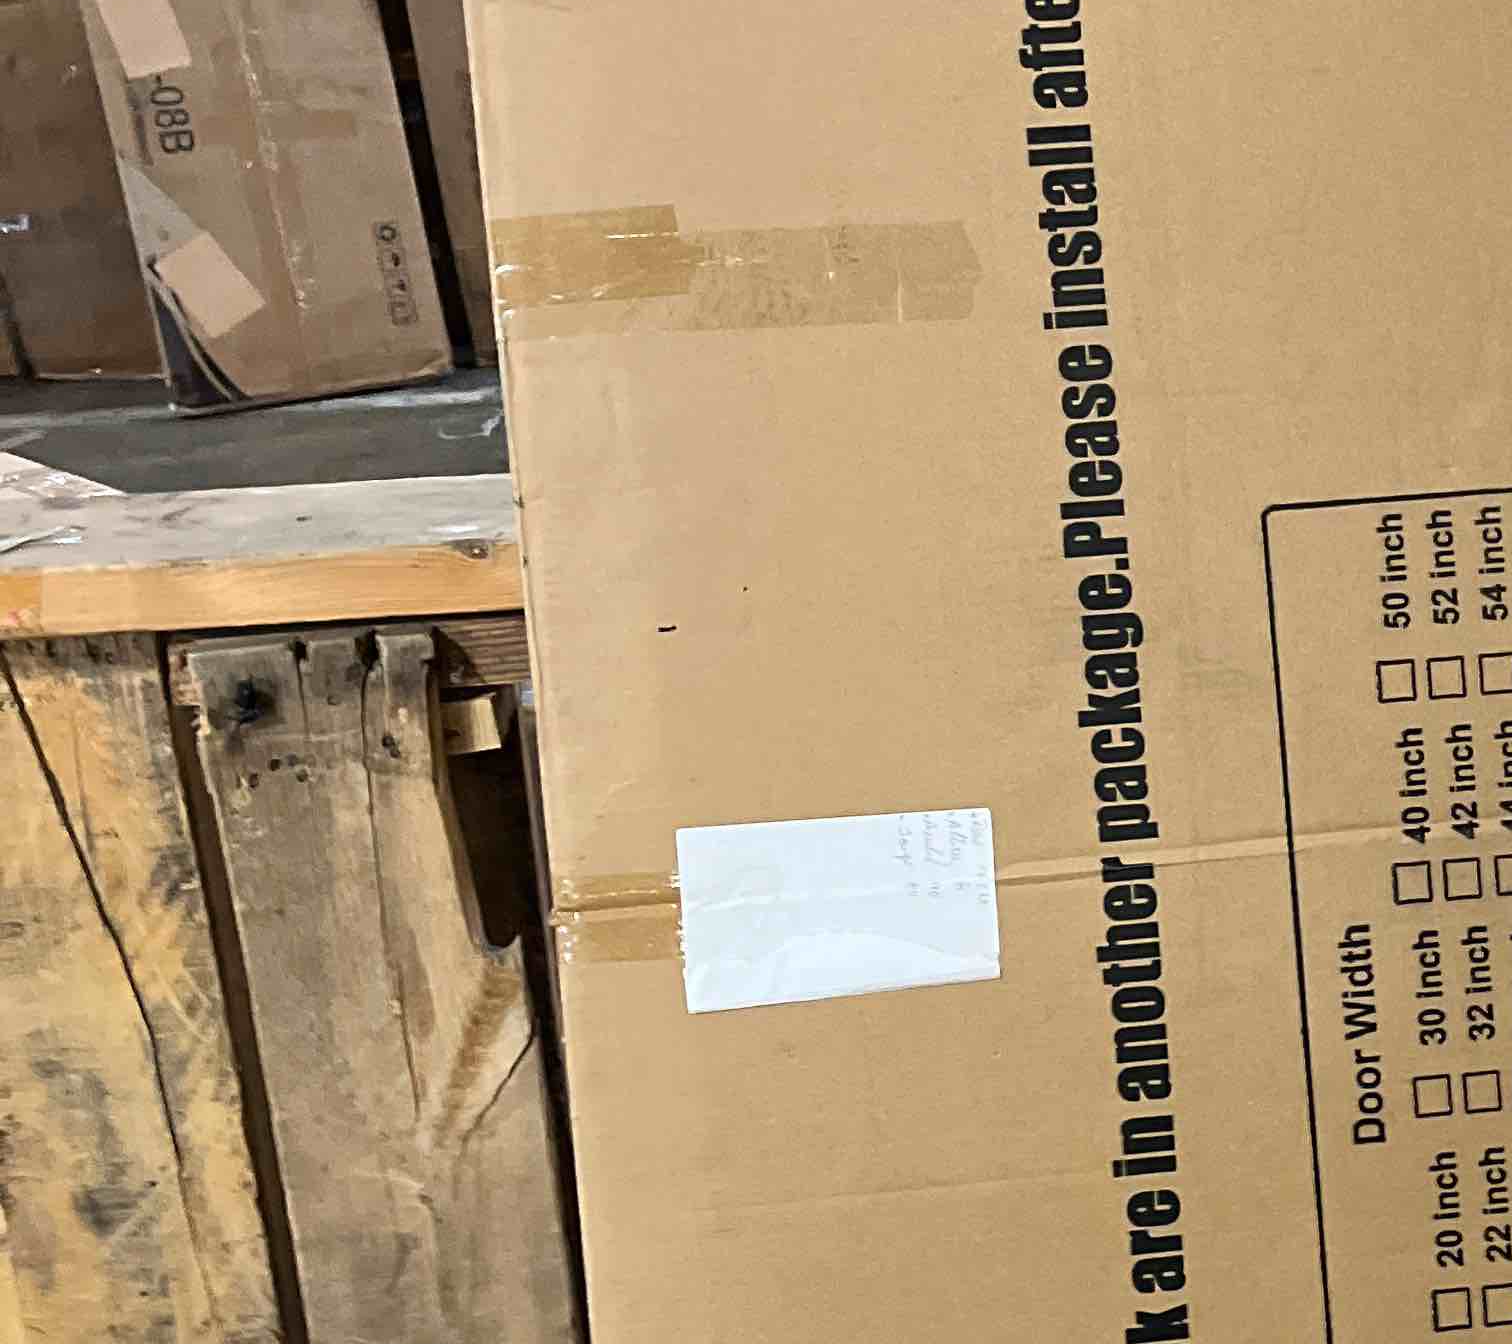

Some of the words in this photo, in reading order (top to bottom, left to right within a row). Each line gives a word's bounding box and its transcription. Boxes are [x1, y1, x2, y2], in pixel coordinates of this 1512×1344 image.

[1027, 125, 1108, 329] install
[1376, 514, 1407, 582] inch
[1426, 511, 1456, 578] inch
[1475, 507, 1505, 574] inch
[1382, 593, 1411, 628] 50
[1431, 588, 1459, 624] 52
[1480, 584, 1508, 620] 54
[1396, 728, 1427, 797] inch
[1445, 724, 1476, 792] inch
[1402, 807, 1430, 844] 40
[1451, 802, 1479, 839] 42
[1096, 857, 1171, 1101] another
[1338, 925, 1377, 1040] Width
[1412, 930, 1443, 998] inch
[1461, 926, 1492, 994] inch
[1418, 1009, 1446, 1045] 30
[1467, 1004, 1495, 1041] 32
[1353, 1049, 1386, 1144] Door
[1113, 1115, 1176, 1177] in
[1429, 1152, 1460, 1220] inch
[1478, 1147, 1509, 1214] inch
[1127, 1190, 1186, 1293] are
[1435, 1230, 1464, 1267] 20
[1484, 1224, 1512, 1262] 22
